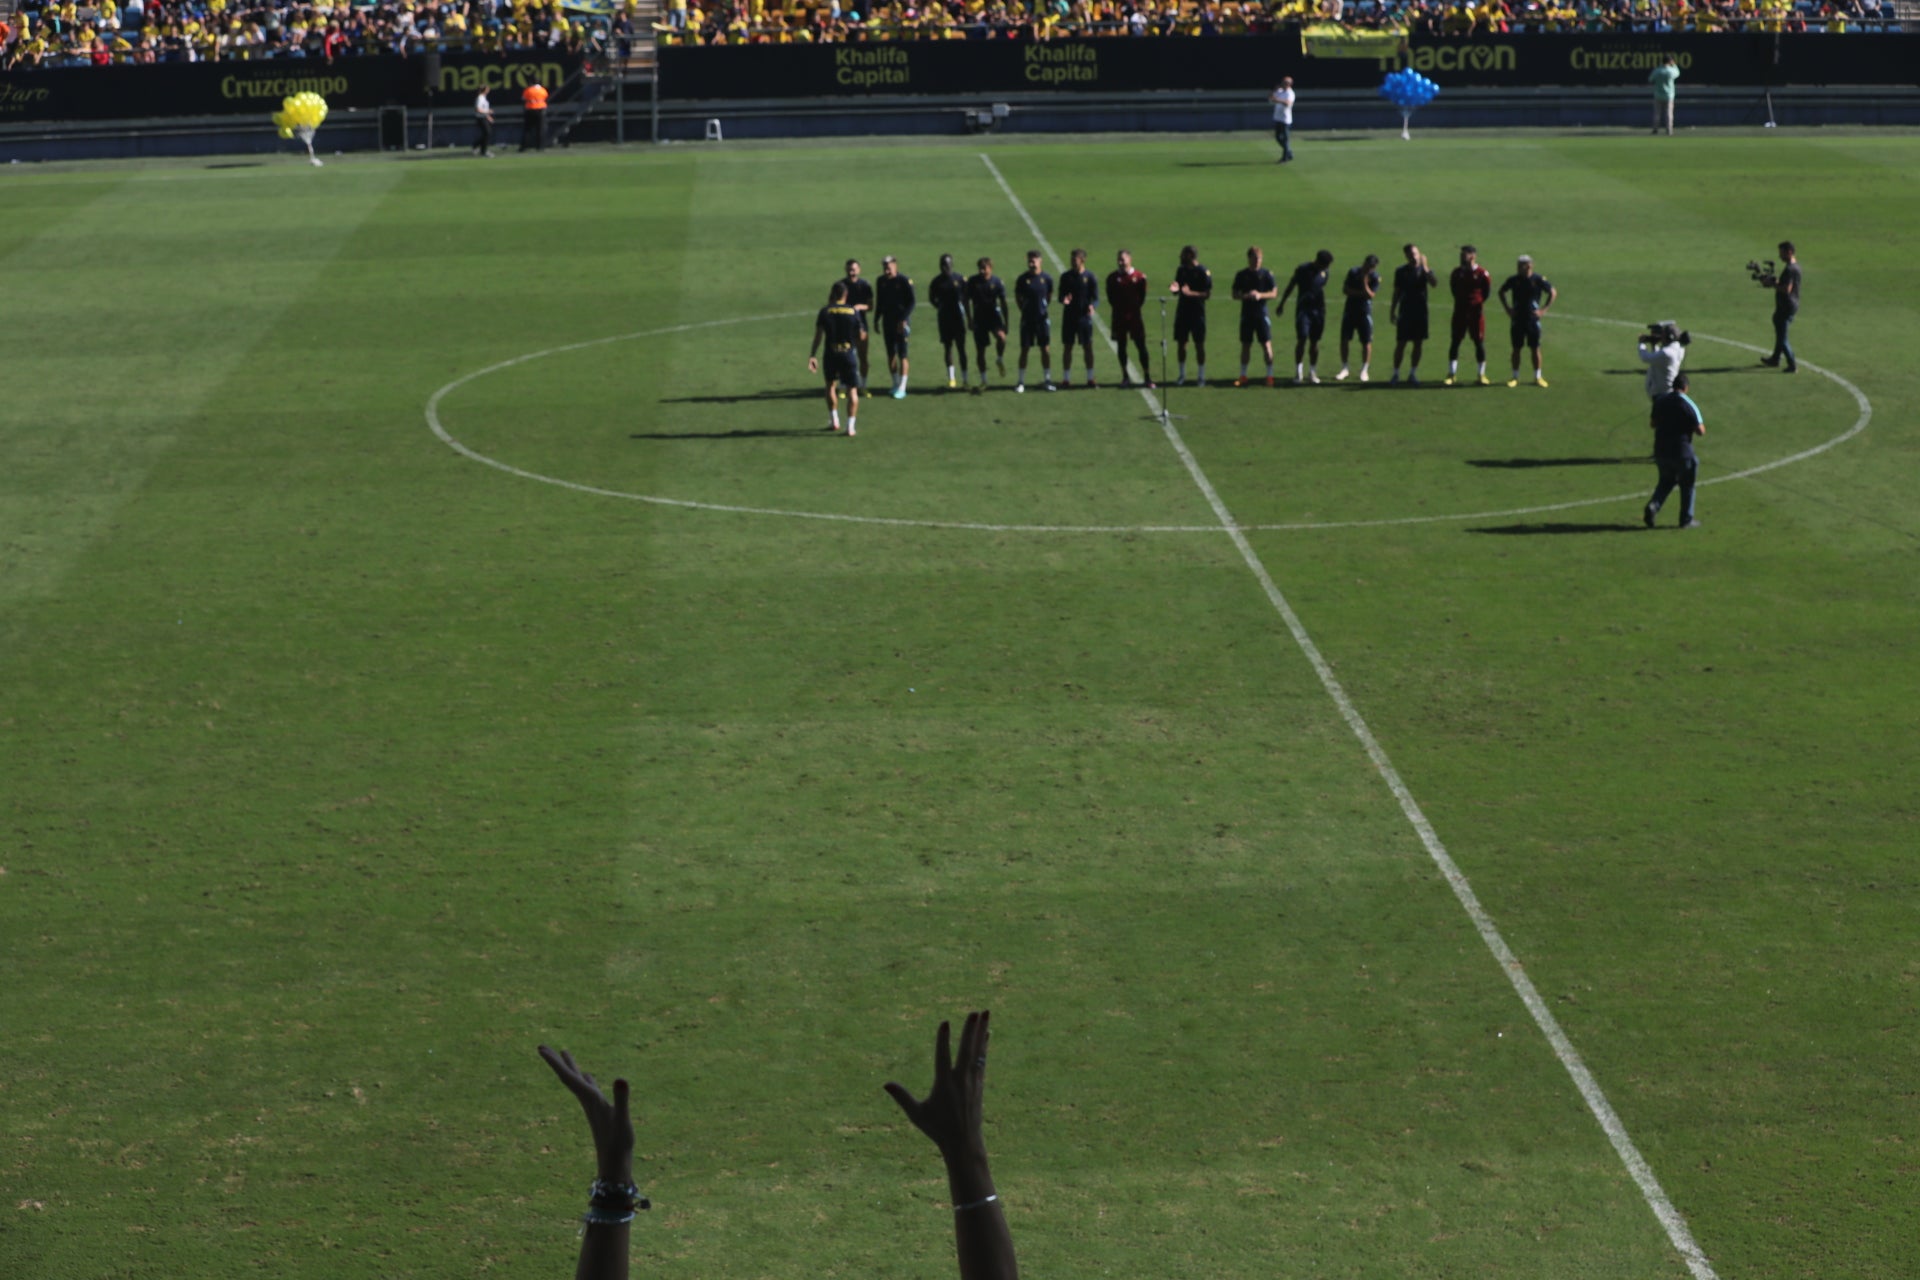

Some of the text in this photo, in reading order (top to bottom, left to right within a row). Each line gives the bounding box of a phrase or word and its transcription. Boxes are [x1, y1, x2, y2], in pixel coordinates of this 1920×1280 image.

[835, 48, 908, 66] Khalifa
[1024, 45, 1096, 62] Khalifa
[836, 66, 910, 87] Capital
[1025, 63, 1098, 84] Capital
